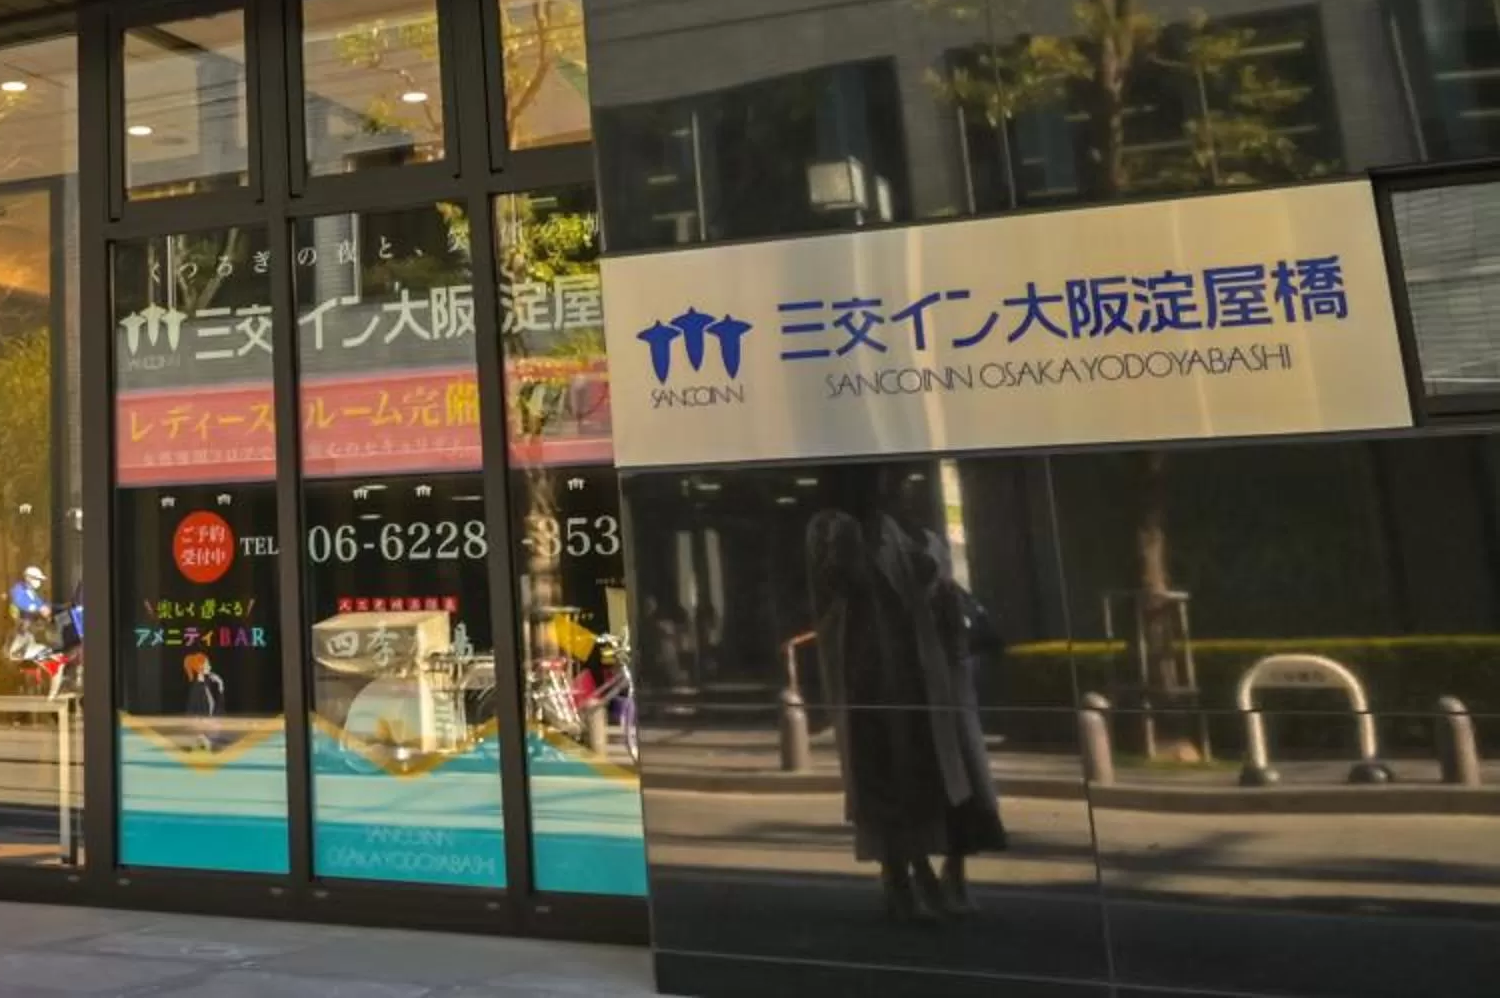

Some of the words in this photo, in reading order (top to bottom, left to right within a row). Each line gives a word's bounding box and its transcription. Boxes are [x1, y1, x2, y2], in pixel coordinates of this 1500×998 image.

[777, 255, 1349, 360] 三交イン大阪淀屋橋
[825, 363, 975, 398] SANCOINN
[980, 356, 1080, 390] OSAKA
[1081, 343, 1293, 382] YODOYABASHI
[651, 385, 745, 408] SANCOINN
[239, 536, 280, 556] TEL
[134, 626, 267, 647] アメニティBAR
